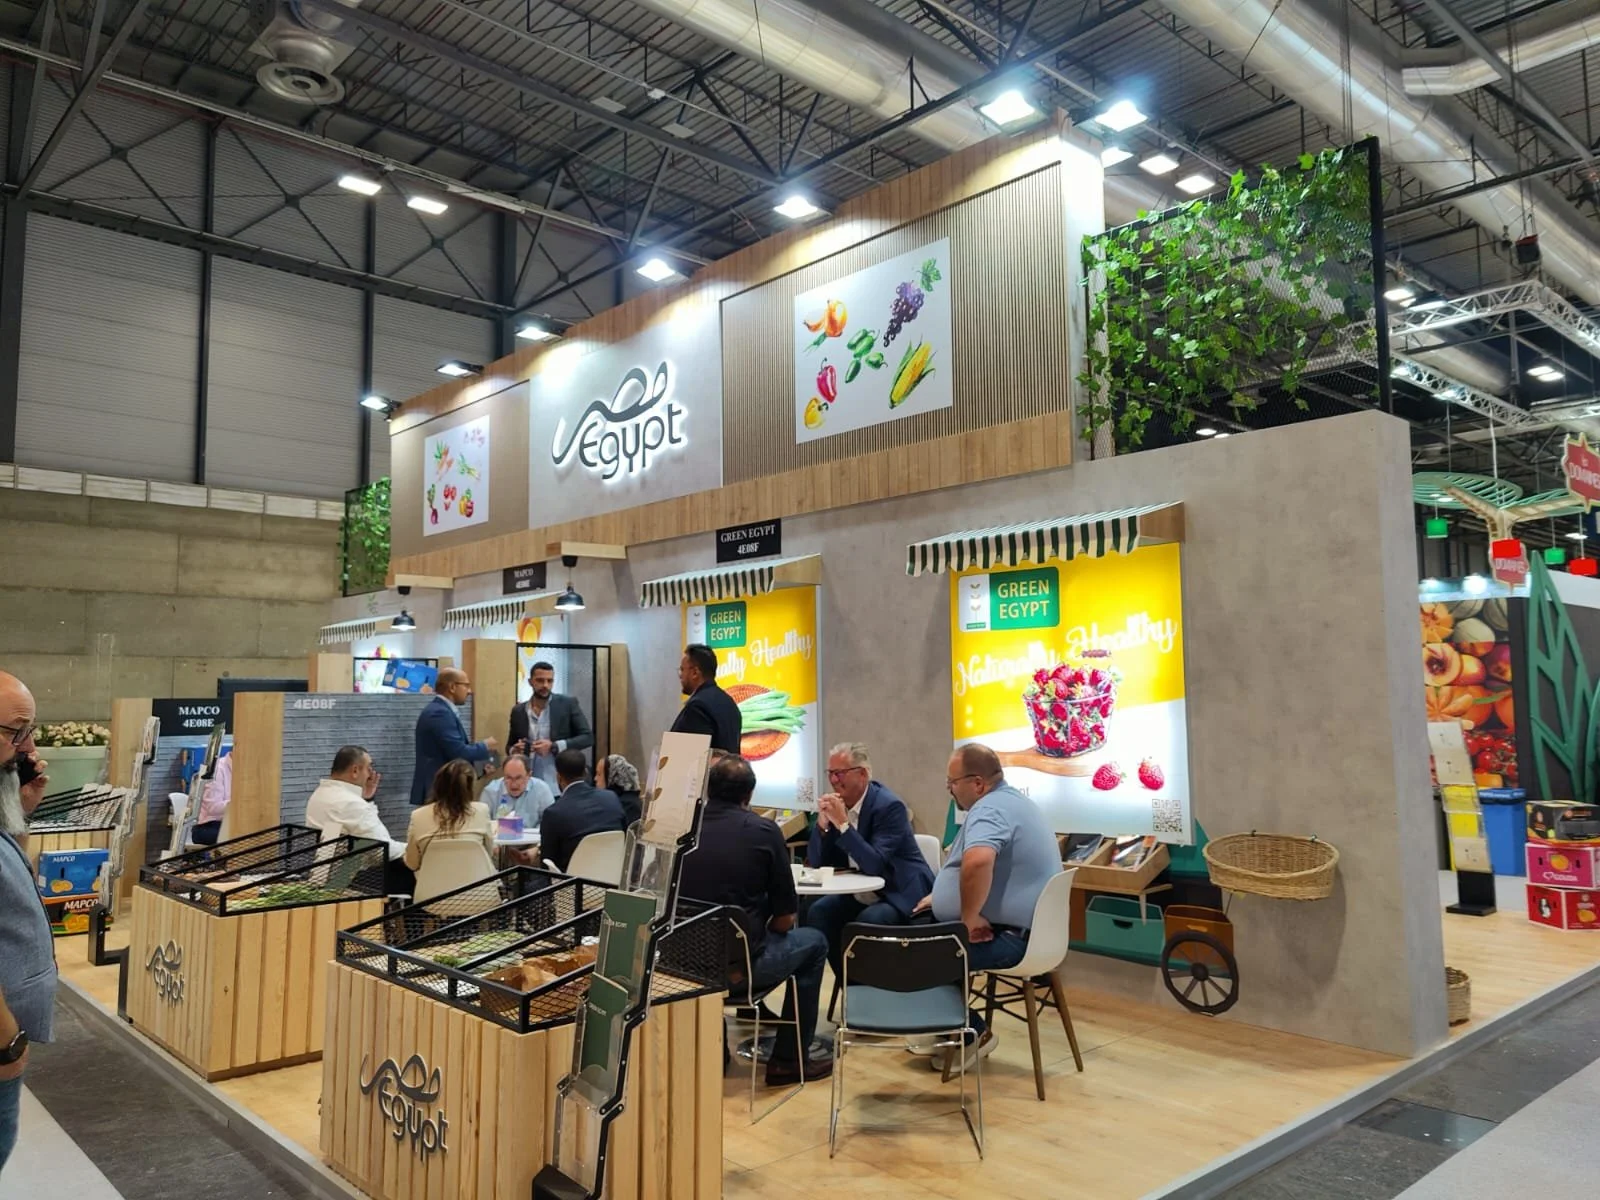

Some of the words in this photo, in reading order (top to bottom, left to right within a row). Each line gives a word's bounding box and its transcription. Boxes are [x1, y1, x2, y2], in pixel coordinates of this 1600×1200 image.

[578, 403, 682, 480] Egypt
[720, 529, 747, 543] GREEN
[748, 524, 775, 538] EGYPT
[737, 542, 760, 554] 4E08F
[997, 580, 1050, 598] GREEN
[710, 610, 741, 625] GREEN
[999, 600, 1050, 619] EGYPT
[710, 626, 742, 641] EGYPT
[1065, 611, 1179, 660] Healthy
[749, 628, 813, 667] Healthy
[178, 705, 221, 717] MAPCO
[293, 699, 337, 710] 4E08F
[181, 718, 215, 728] 4E08E
[377, 1075, 449, 1162] Egypt
